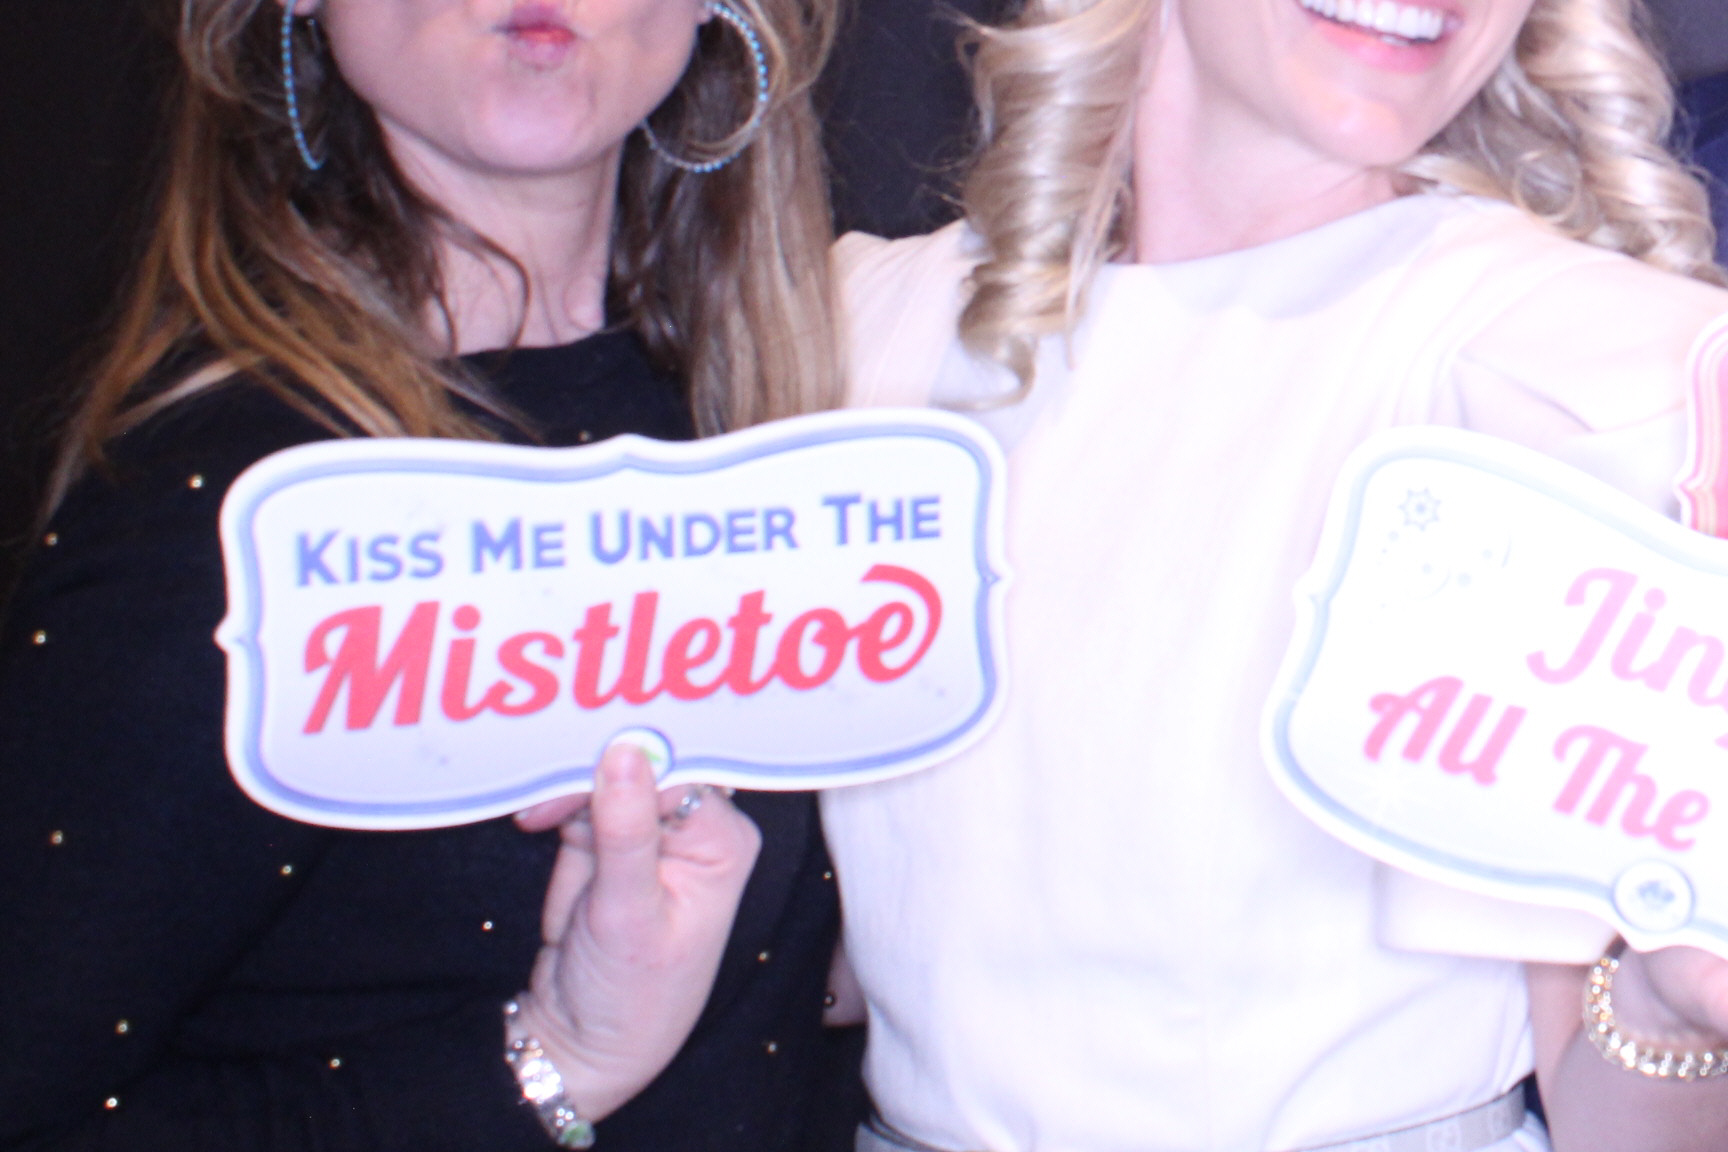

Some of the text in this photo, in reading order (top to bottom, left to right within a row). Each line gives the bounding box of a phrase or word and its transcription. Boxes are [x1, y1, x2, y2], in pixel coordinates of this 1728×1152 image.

[296, 493, 942, 587] KISS ME UNDER THE
[302, 563, 943, 735] Mistletoe
[1361, 675, 1528, 788] All
[1552, 724, 1712, 853] The
